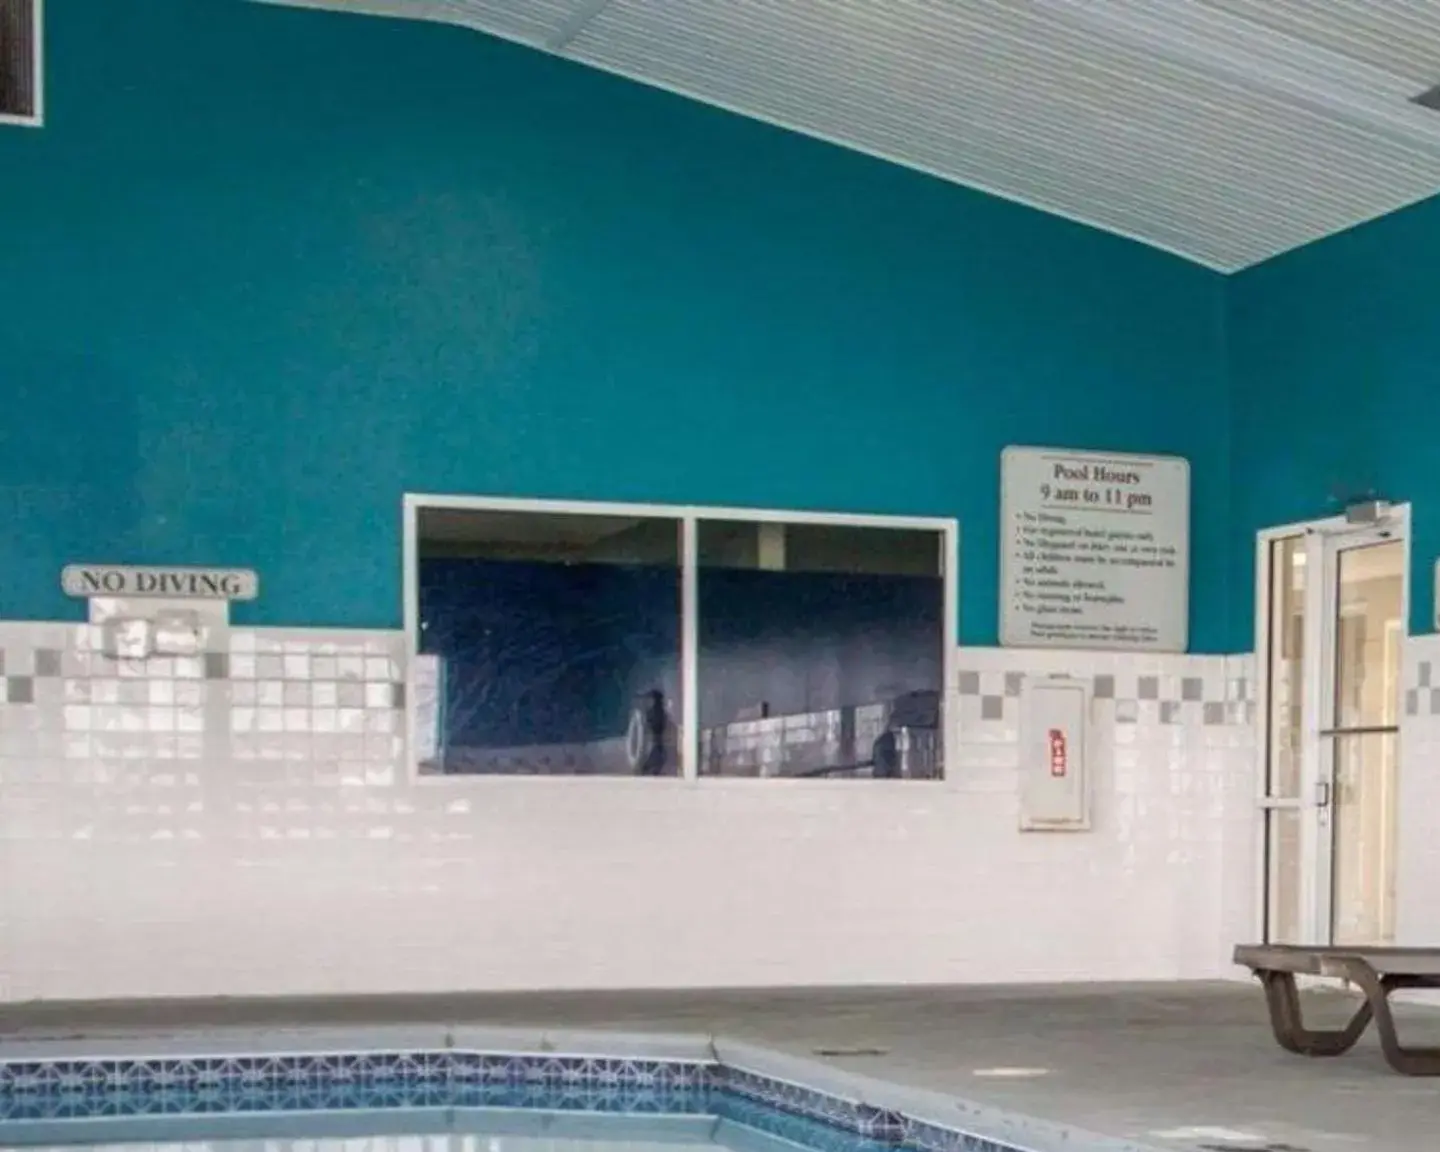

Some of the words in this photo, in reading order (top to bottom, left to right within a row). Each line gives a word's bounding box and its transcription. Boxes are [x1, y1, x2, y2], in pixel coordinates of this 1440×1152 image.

[1053, 463, 1089, 480] Pool
[1093, 466, 1141, 484] Hours
[1040, 484, 1050, 500] 9
[1055, 488, 1078, 501] am
[1083, 487, 1099, 502] to
[1105, 488, 1122, 505] 11
[1126, 493, 1153, 508] pm
[81, 570, 125, 592] NO
[136, 571, 240, 595] DIVING
